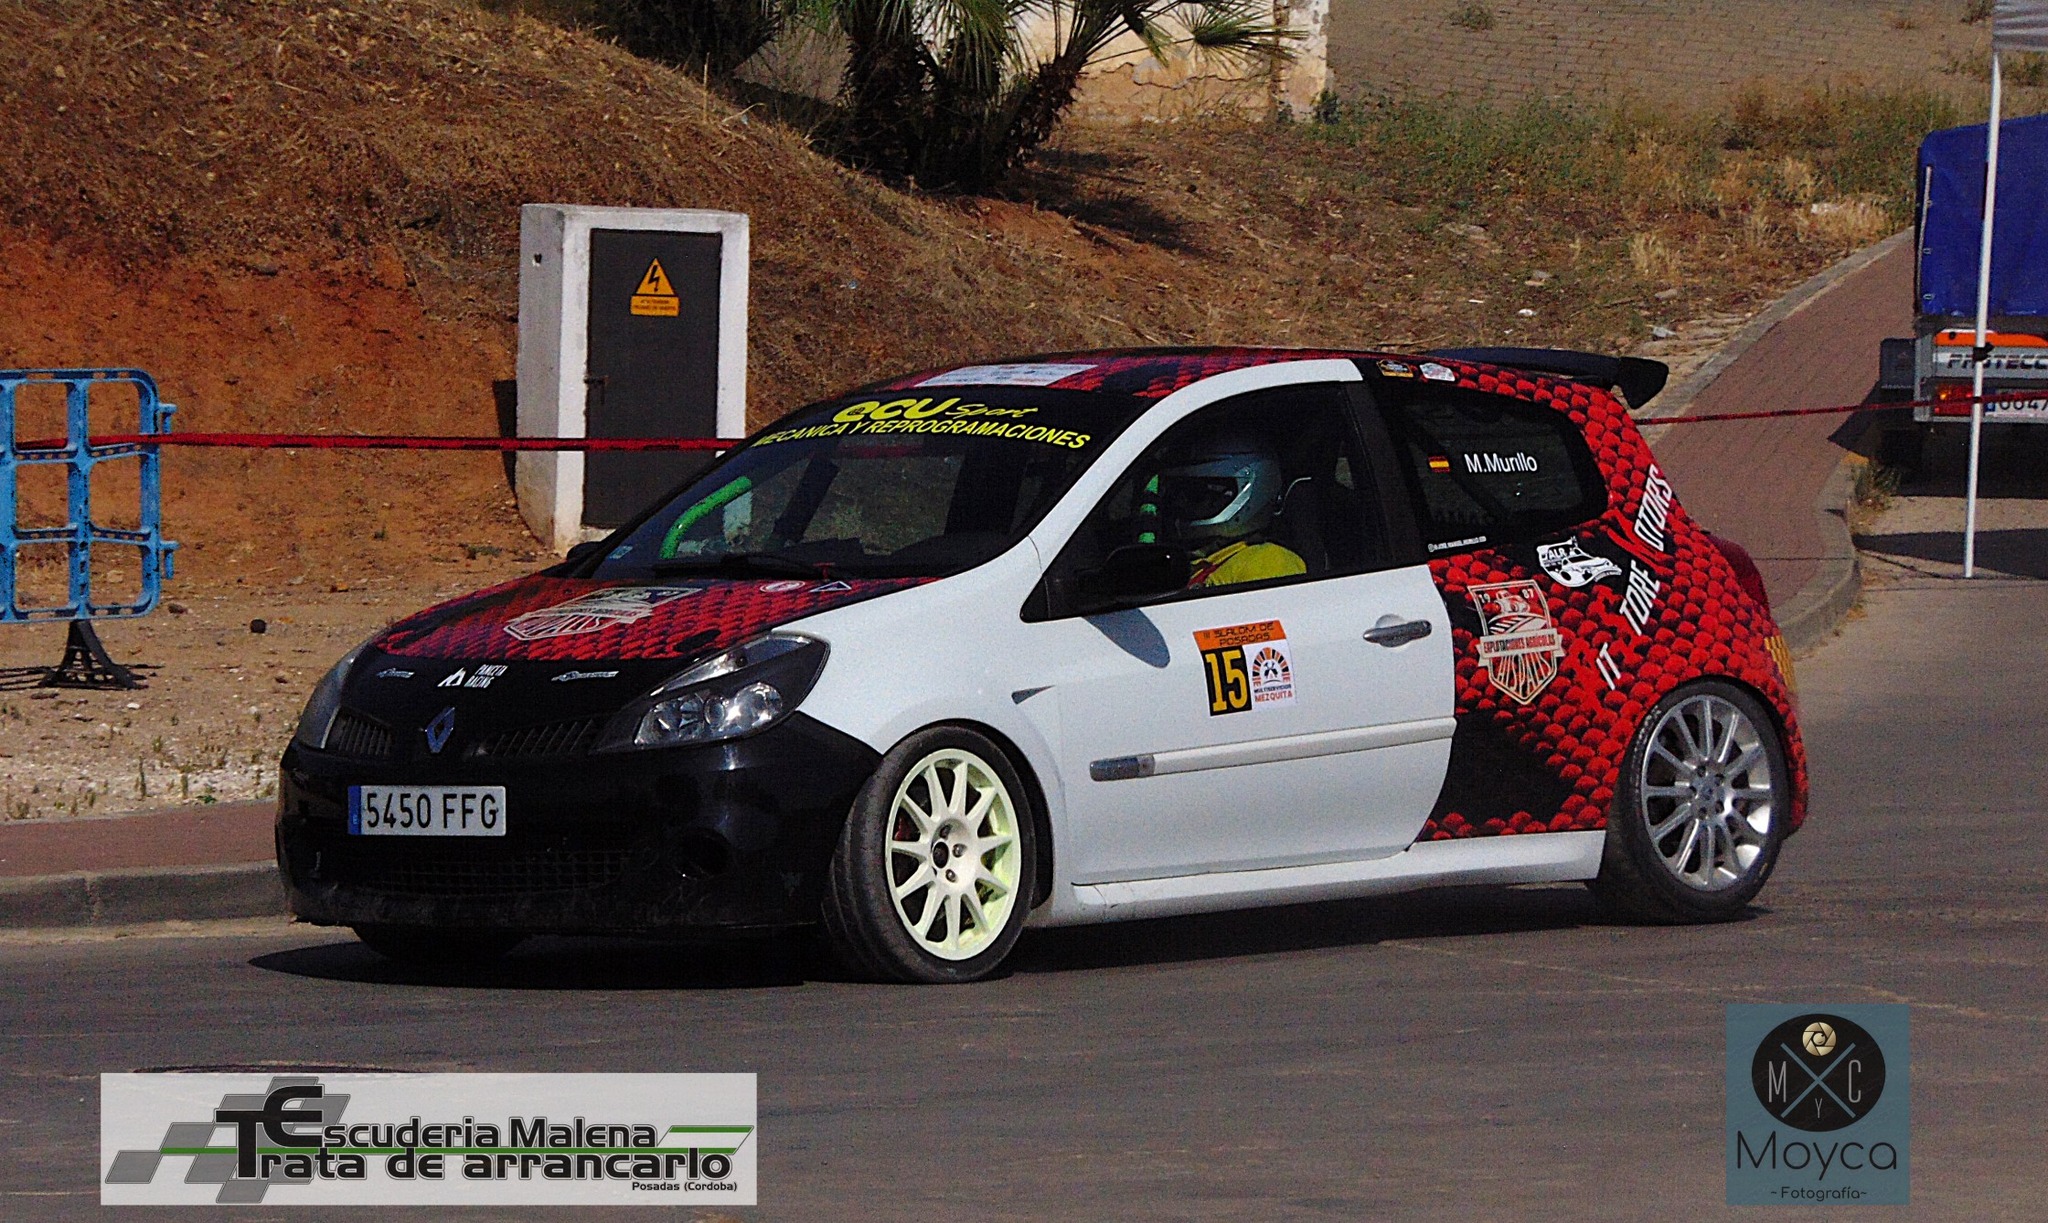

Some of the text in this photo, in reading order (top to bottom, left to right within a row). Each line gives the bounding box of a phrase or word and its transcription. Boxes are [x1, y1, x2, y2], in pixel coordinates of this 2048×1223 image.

[945, 404, 1038, 419] Sport
[751, 419, 1090, 448] MECANICA Y REPROGRAMACIONES
[1464, 452, 1538, 473] M.Murillo
[1205, 649, 1248, 712] 15
[1255, 690, 1293, 702] MEZQUITA
[367, 793, 498, 829] 5450 FFG
